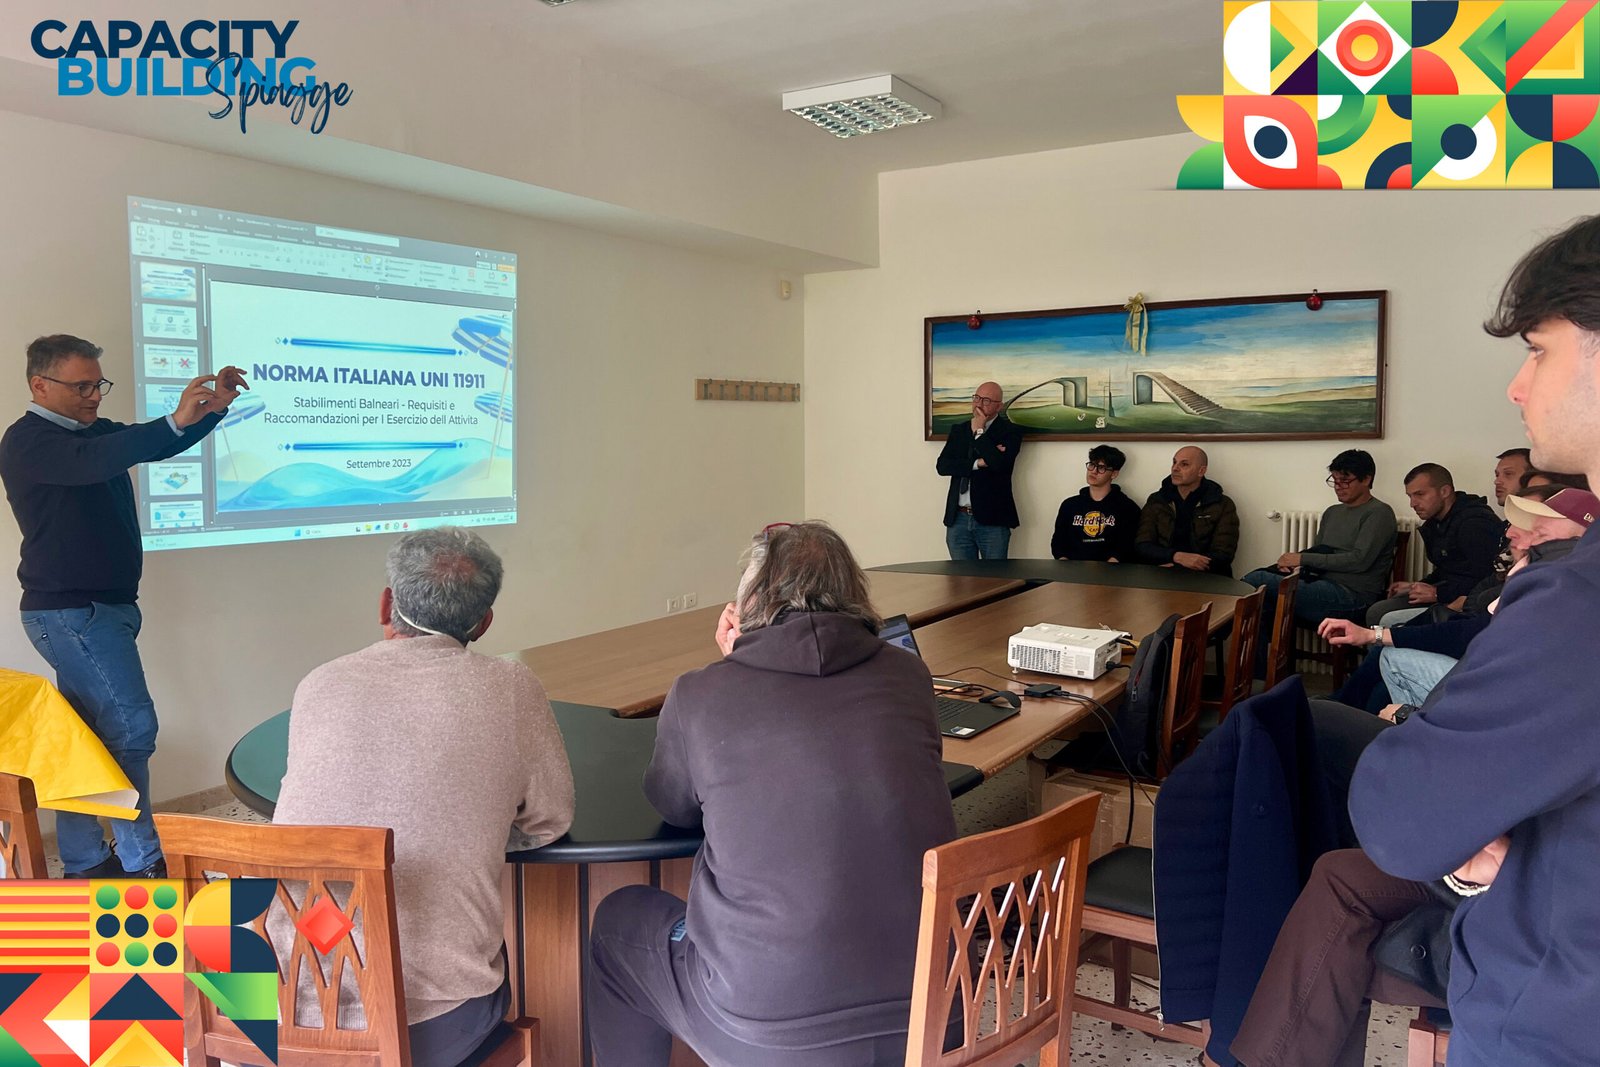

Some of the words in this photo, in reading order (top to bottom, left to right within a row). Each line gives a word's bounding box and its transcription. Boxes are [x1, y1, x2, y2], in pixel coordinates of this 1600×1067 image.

[253, 363, 329, 383] NORMA
[333, 367, 417, 387] ITALIANA
[421, 371, 449, 388] UNI
[453, 373, 485, 389] 11911
[293, 396, 357, 409] Stabilimenti
[359, 398, 399, 410] Balneari
[407, 399, 448, 411] Requisiti
[449, 402, 455, 411] e
[264, 412, 360, 425] Raccomandazioni
[362, 415, 379, 426] per
[386, 414, 428, 425] Esercizio
[430, 414, 447, 425] dell
[448, 415, 478, 425] Attivita
[346, 459, 391, 469] Settembre
[392, 458, 412, 468] 2023
[1072, 515, 1095, 526] Hard
